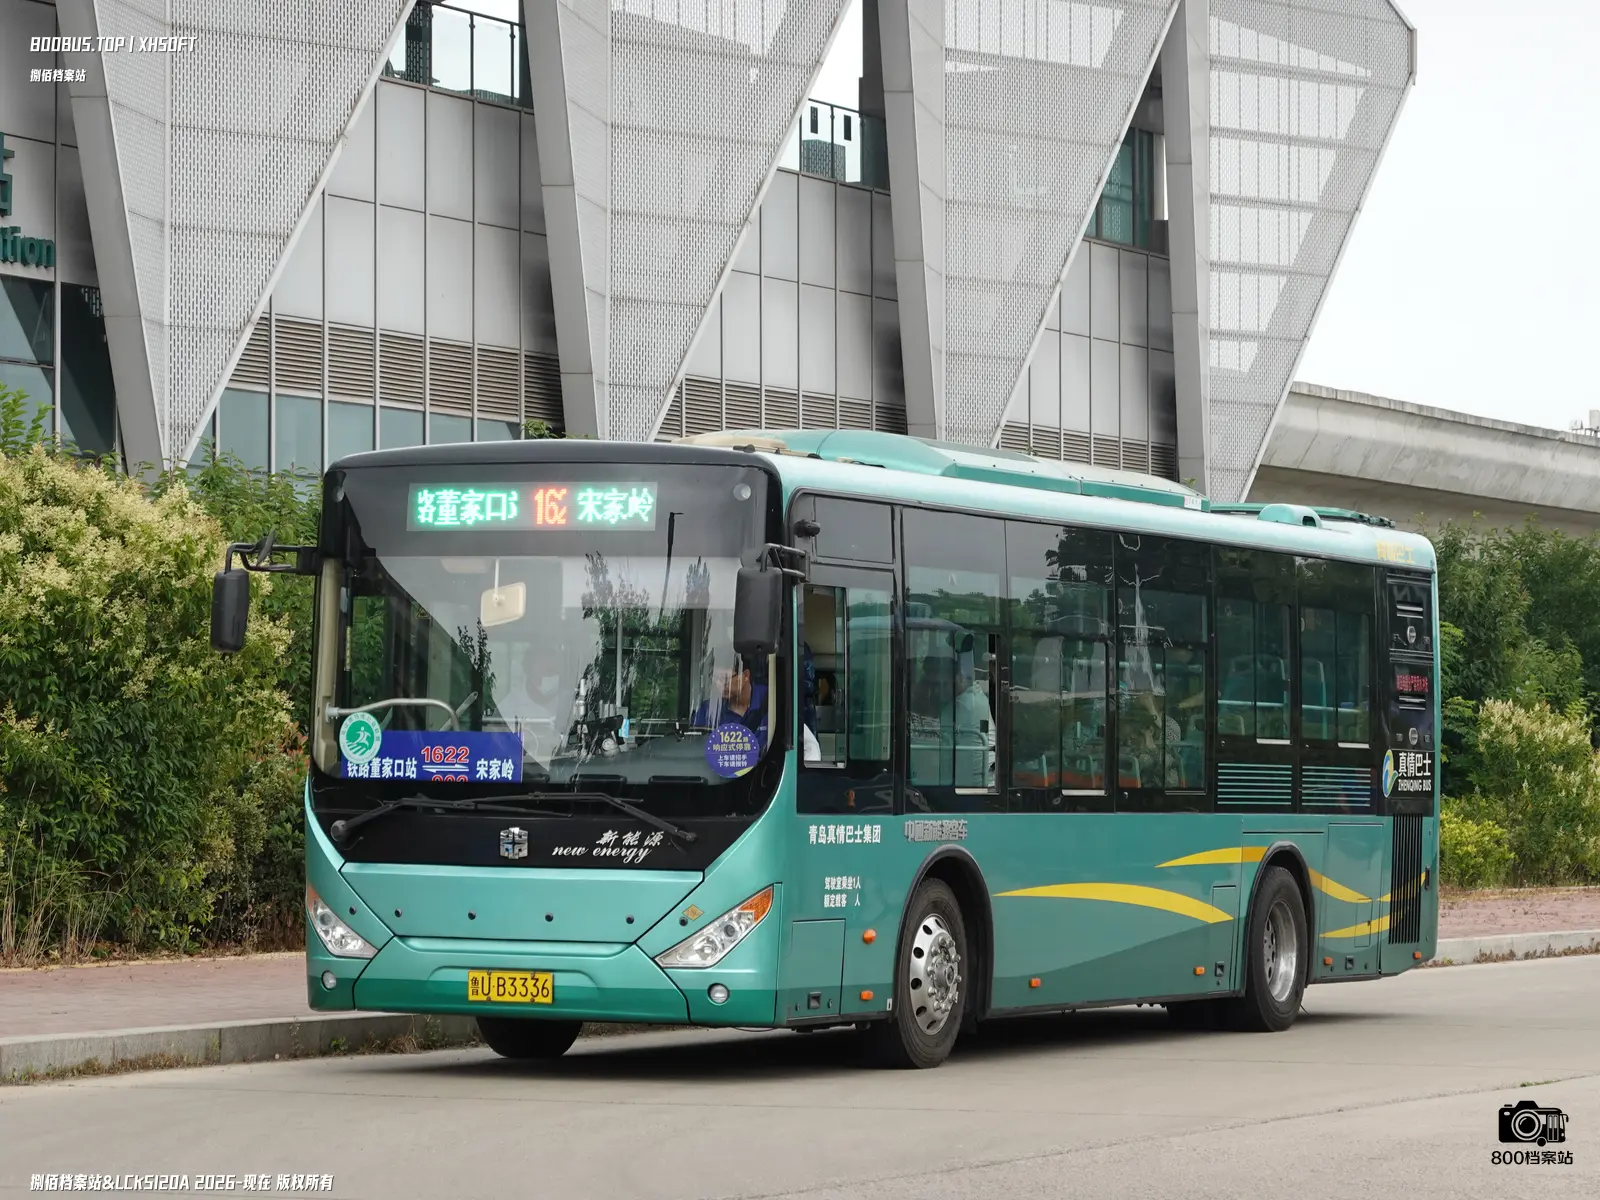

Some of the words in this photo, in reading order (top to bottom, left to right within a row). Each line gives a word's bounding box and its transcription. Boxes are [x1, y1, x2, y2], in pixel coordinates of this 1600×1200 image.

[0, 226, 55, 267] tion
[577, 488, 654, 524] 宋家岭
[421, 746, 469, 763] 1622
[1398, 752, 1432, 777] 真情巴士
[476, 758, 514, 780] 宋家岭
[1398, 779, 1422, 792] ZHENQING
[1423, 779, 1432, 792] BUS
[595, 829, 664, 847] 新能源
[808, 824, 881, 844] 青岛真情巴士集团
[552, 844, 589, 857] new
[592, 843, 652, 864] energy
[854, 893, 861, 907] 人
